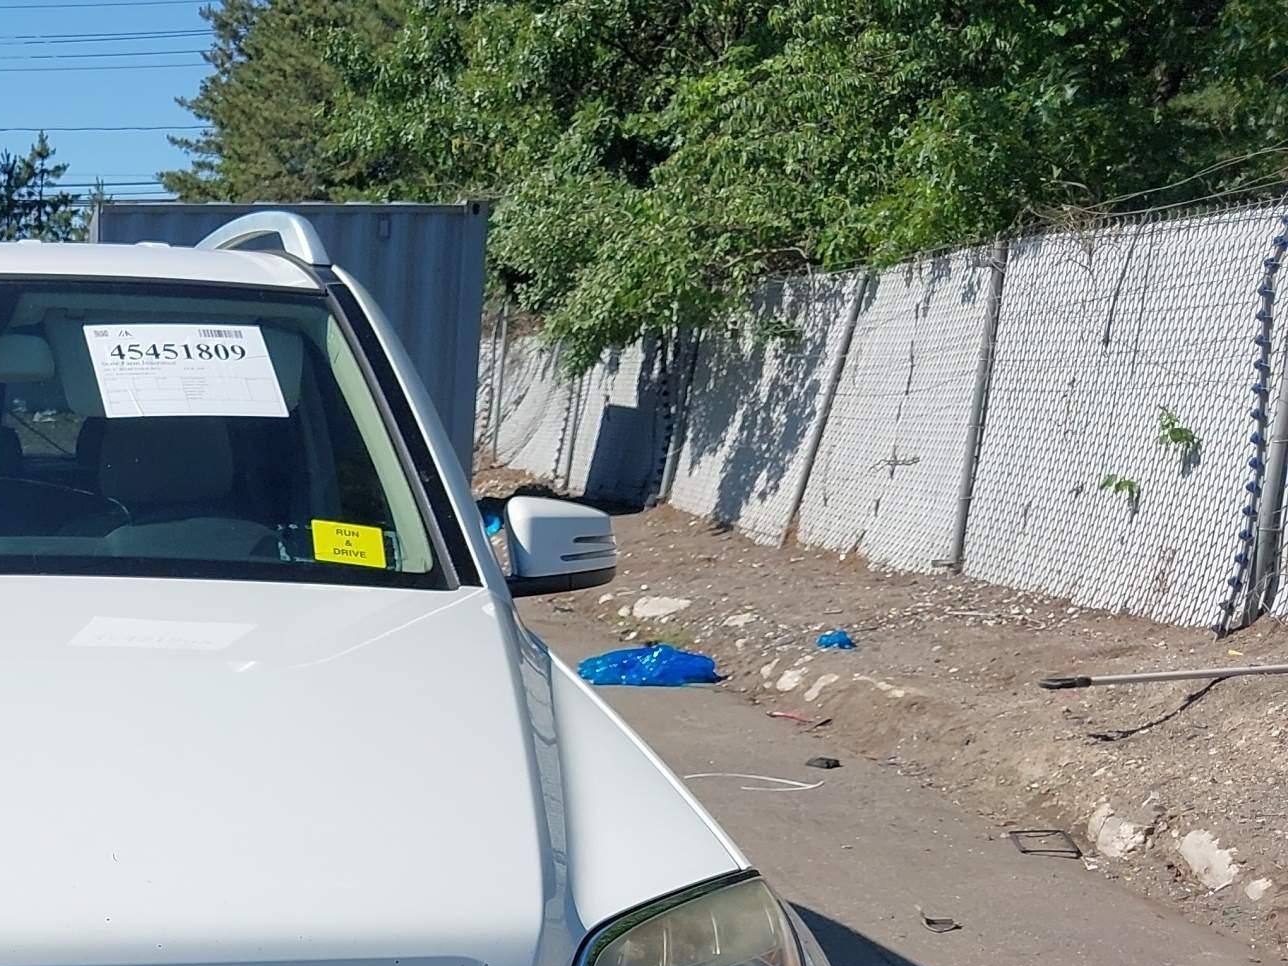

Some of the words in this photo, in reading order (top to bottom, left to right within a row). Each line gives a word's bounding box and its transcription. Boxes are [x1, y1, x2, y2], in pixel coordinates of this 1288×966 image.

[110, 343, 247, 361] 45451809
[335, 528, 360, 538] RUN
[344, 539, 353, 547] &
[333, 547, 367, 559] DRIVE
